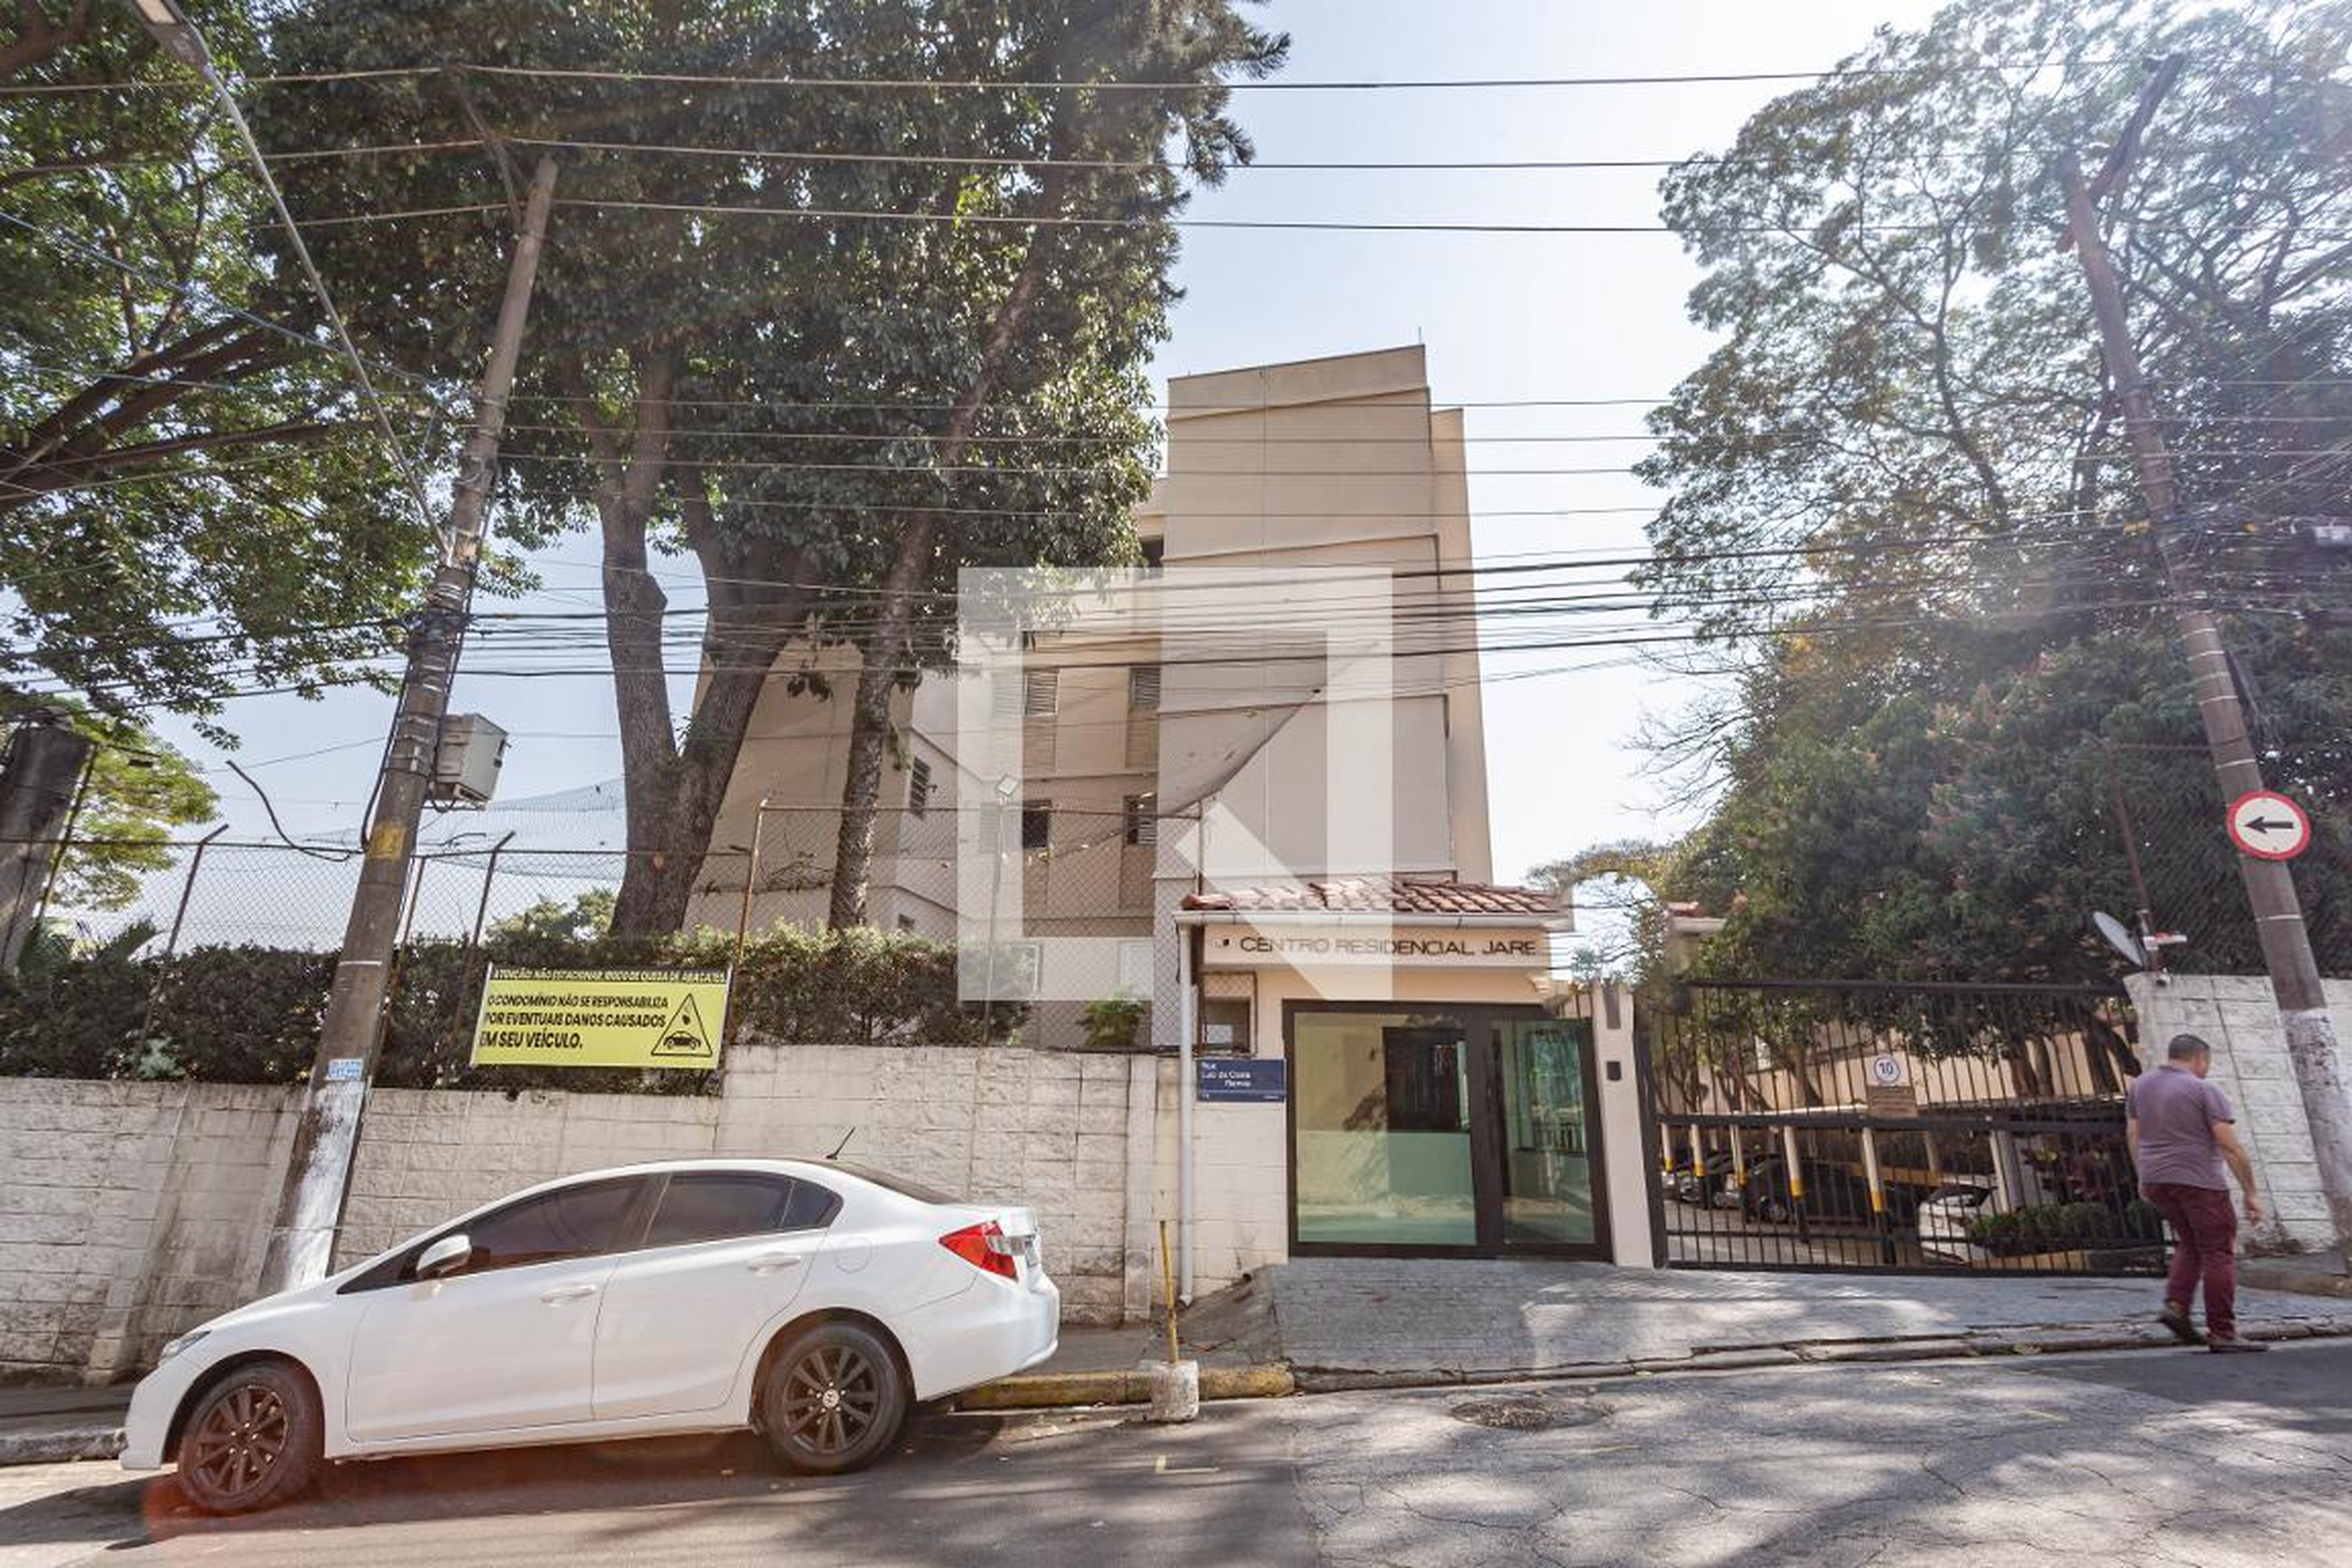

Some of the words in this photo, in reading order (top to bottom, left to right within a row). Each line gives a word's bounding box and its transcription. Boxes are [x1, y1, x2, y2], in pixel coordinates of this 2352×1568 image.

[1240, 937, 1329, 953] CENTRO
[1335, 938, 1475, 956] RESIDENCIAL
[1482, 940, 1537, 956] JARE
[495, 992, 557, 1006] CONDOMÍNIO
[558, 993, 579, 1007] NÃO
[579, 996, 591, 1007] SE
[506, 1012, 563, 1026] EVENTUAIS
[564, 1013, 604, 1027] DANOS
[605, 1014, 666, 1028] CAUSADOS
[480, 1031, 499, 1046] EM
[498, 1031, 524, 1047] SEU
[526, 1027, 583, 1049] VEÍCULO.
[1879, 1061, 1894, 1076] 10
